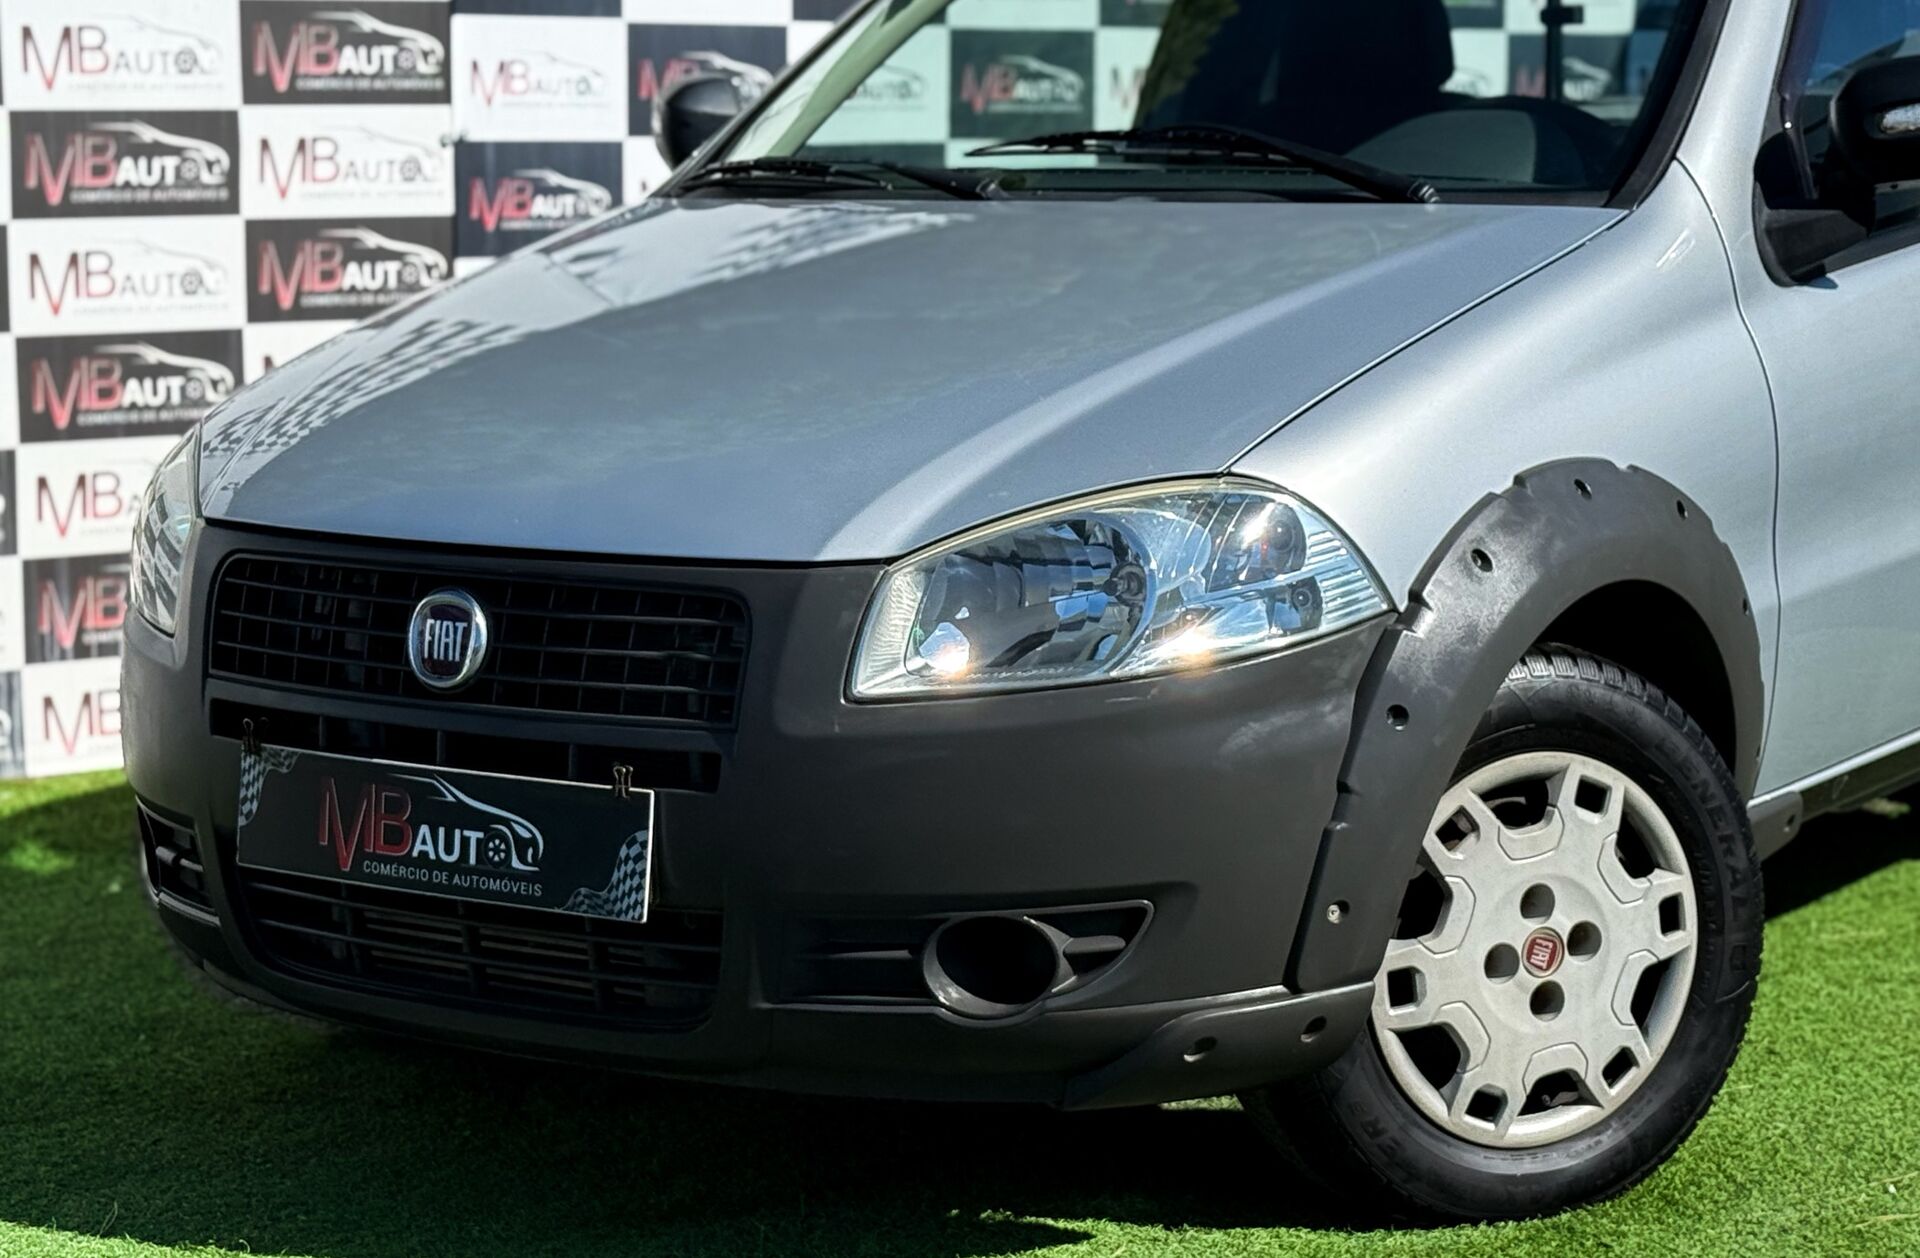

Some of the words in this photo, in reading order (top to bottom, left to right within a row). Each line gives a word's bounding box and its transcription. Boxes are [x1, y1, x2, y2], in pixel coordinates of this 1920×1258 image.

[424, 618, 468, 662] FIAT
[363, 860, 429, 882] COMÉRCIO
[432, 870, 449, 885] DE
[452, 872, 543, 897] AUTOMÓVEIS
[1530, 938, 1554, 970] FIAT
